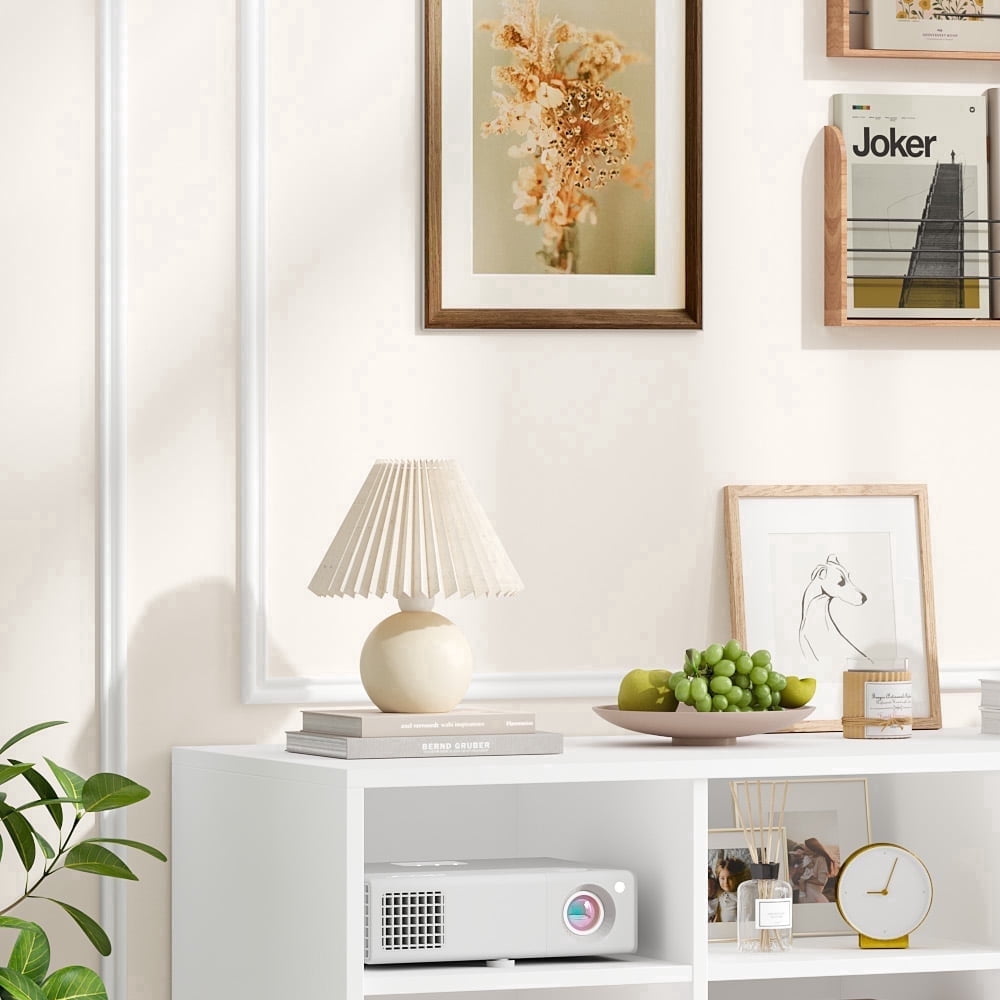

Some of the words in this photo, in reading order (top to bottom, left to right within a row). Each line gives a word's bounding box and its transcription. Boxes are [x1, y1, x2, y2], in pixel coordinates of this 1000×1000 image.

[852, 126, 937, 157] Joker
[422, 743, 452, 751] BERND
[454, 741, 490, 750] GRUBER
